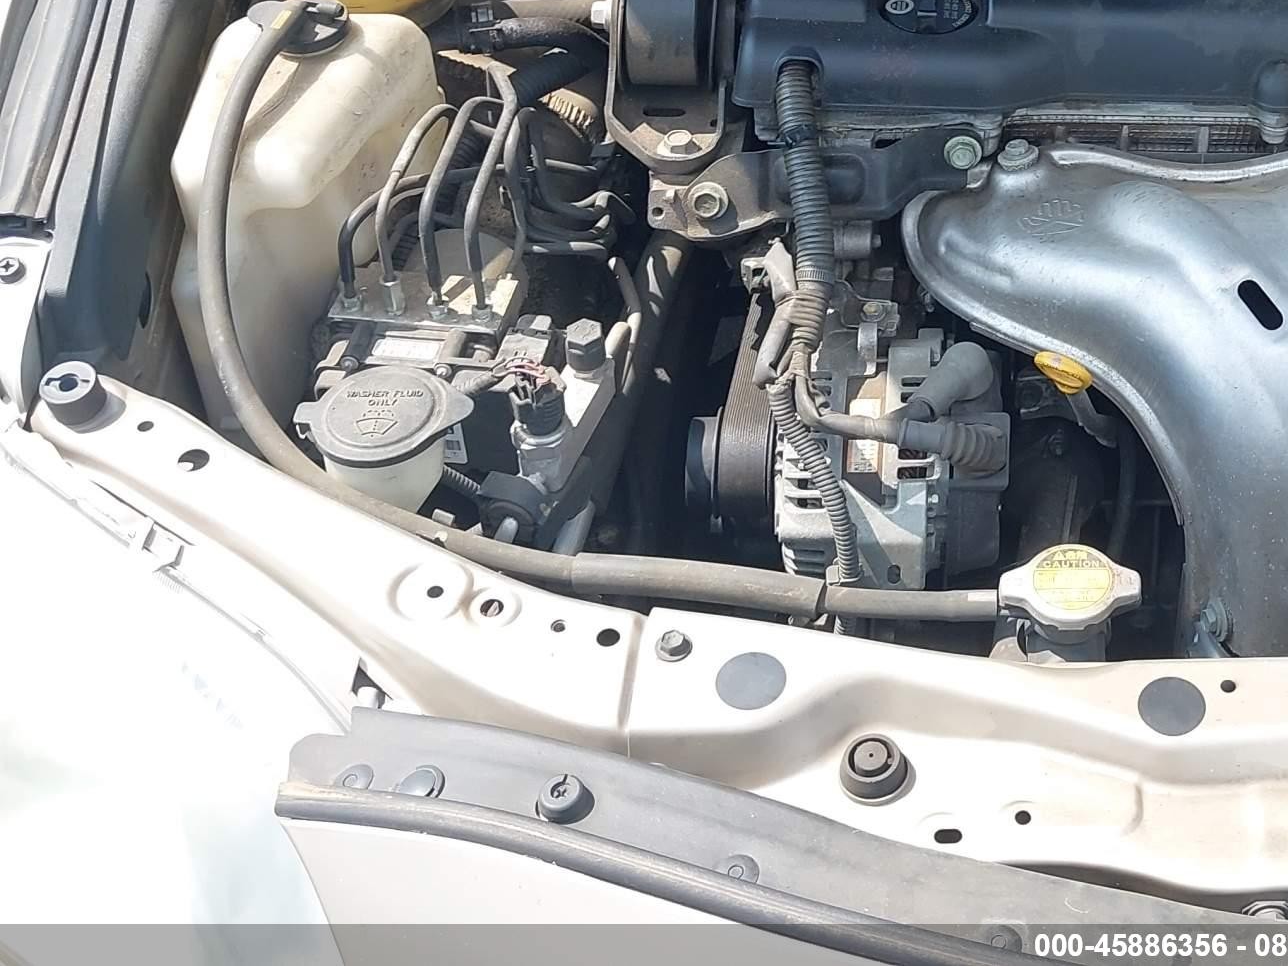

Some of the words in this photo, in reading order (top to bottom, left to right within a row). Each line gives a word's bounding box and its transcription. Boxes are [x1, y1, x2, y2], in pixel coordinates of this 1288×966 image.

[346, 389, 389, 398] WASHER
[393, 389, 424, 398] FLUID
[367, 398, 398, 407] ONLY
[1042, 560, 1100, 569] CAUTION
